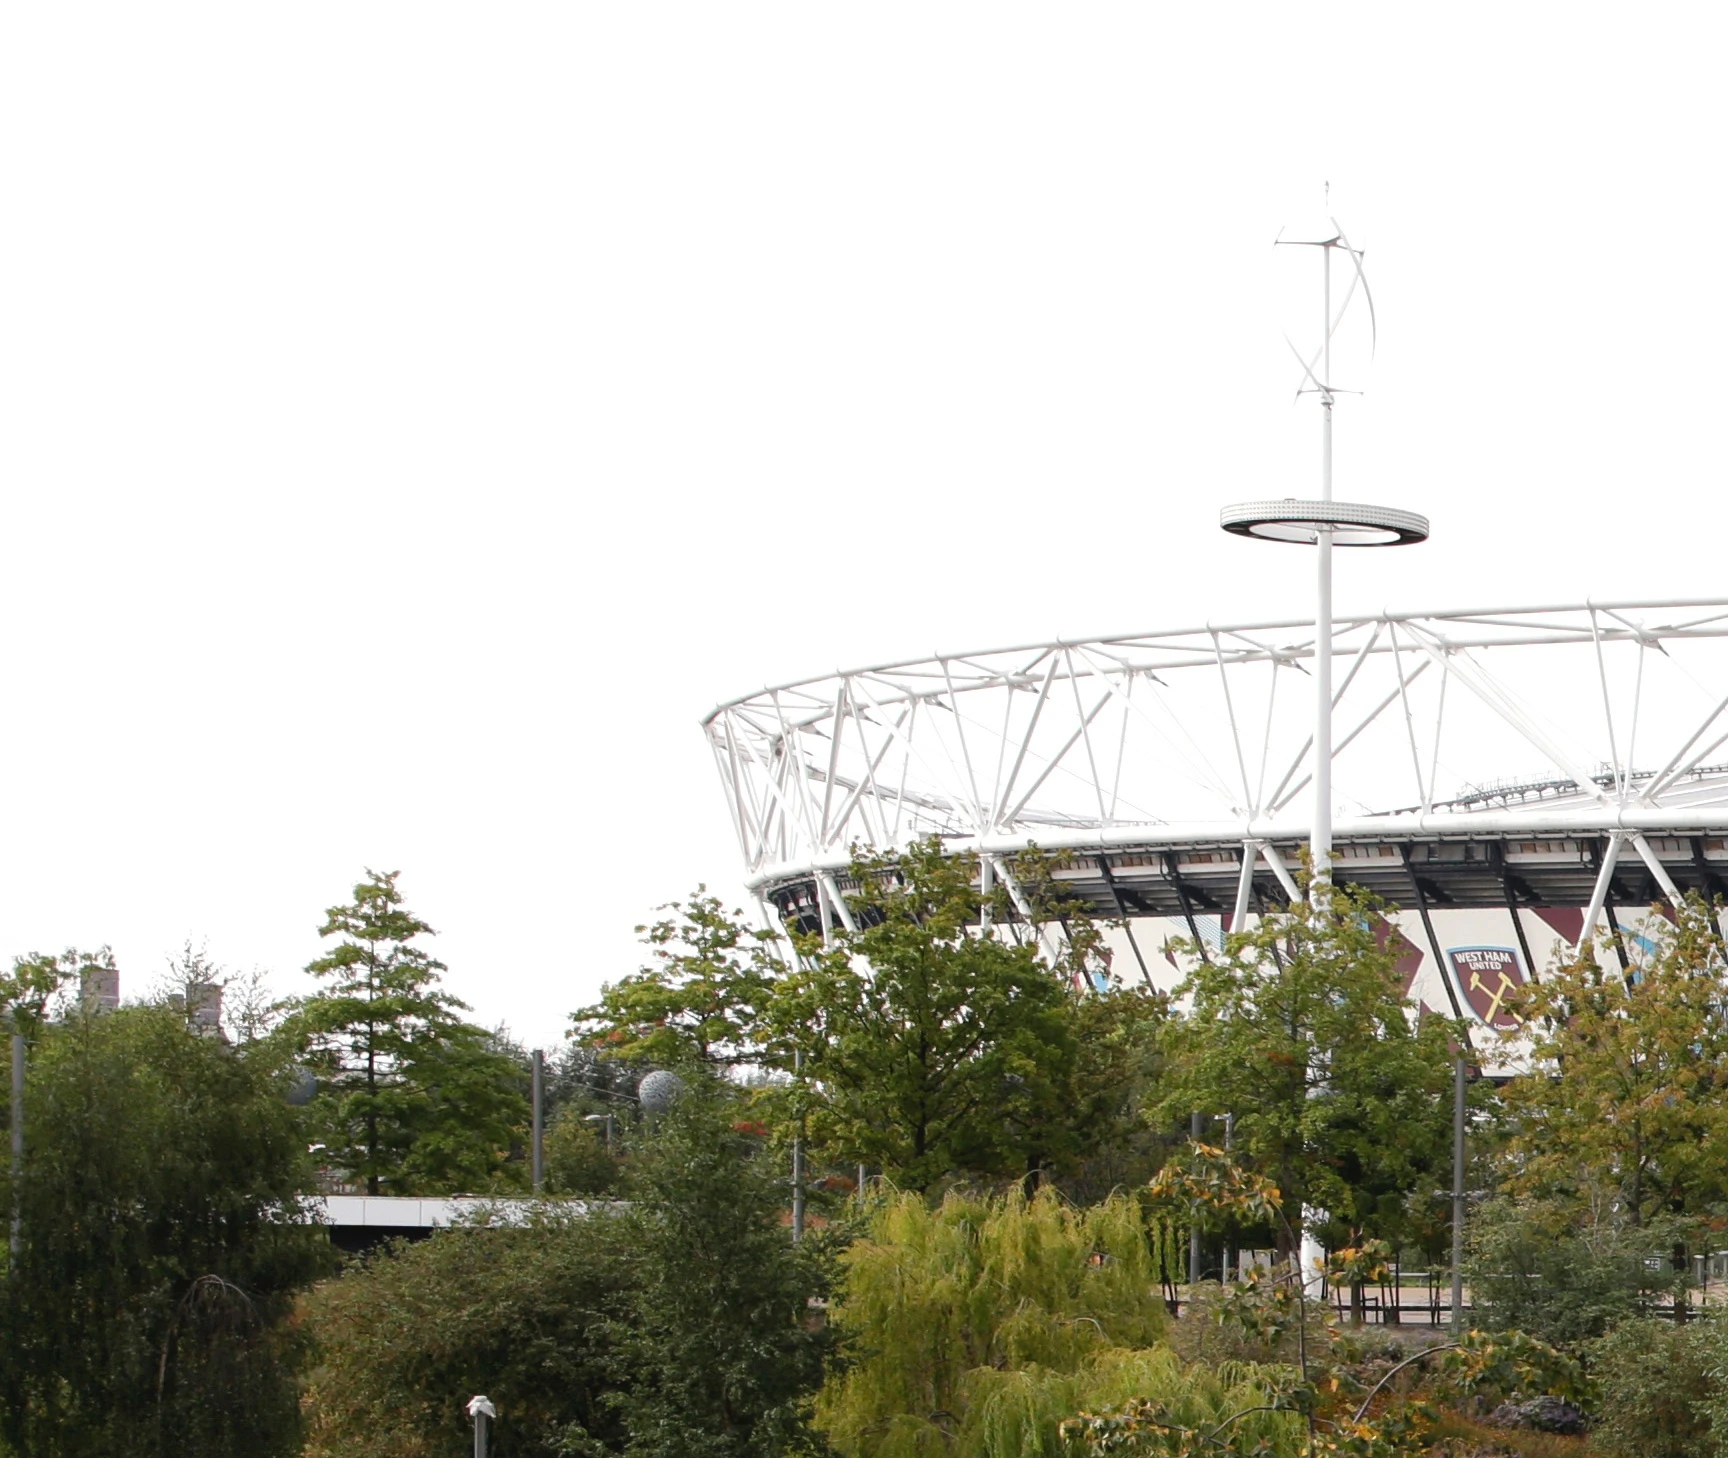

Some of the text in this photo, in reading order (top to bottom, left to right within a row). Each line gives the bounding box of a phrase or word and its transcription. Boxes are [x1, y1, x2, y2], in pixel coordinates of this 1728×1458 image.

[1454, 951, 1512, 963] WEST HAM
[1469, 961, 1502, 970] UNITED
